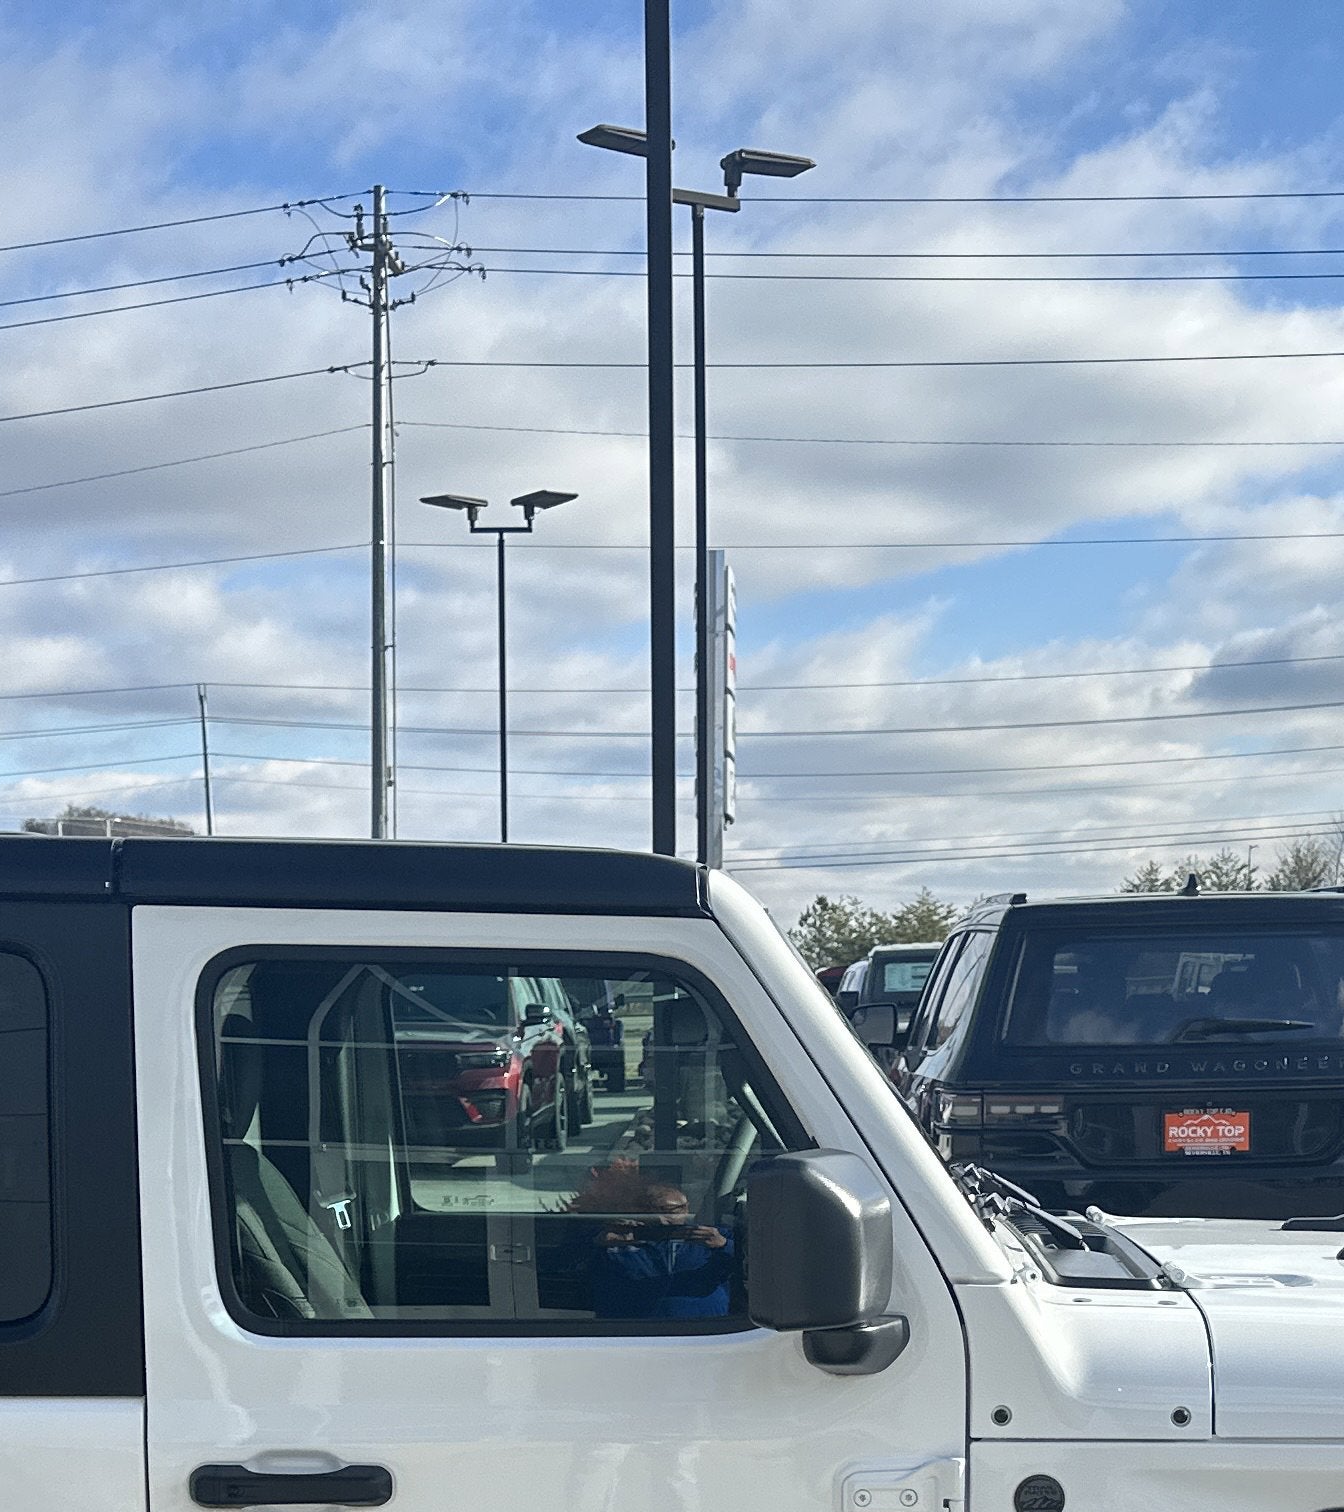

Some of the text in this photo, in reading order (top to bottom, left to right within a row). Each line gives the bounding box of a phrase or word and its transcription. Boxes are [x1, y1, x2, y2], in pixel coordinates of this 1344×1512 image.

[1070, 1062, 1171, 1075] GRAND
[1169, 1125, 1245, 1137] ROCKY TOP
